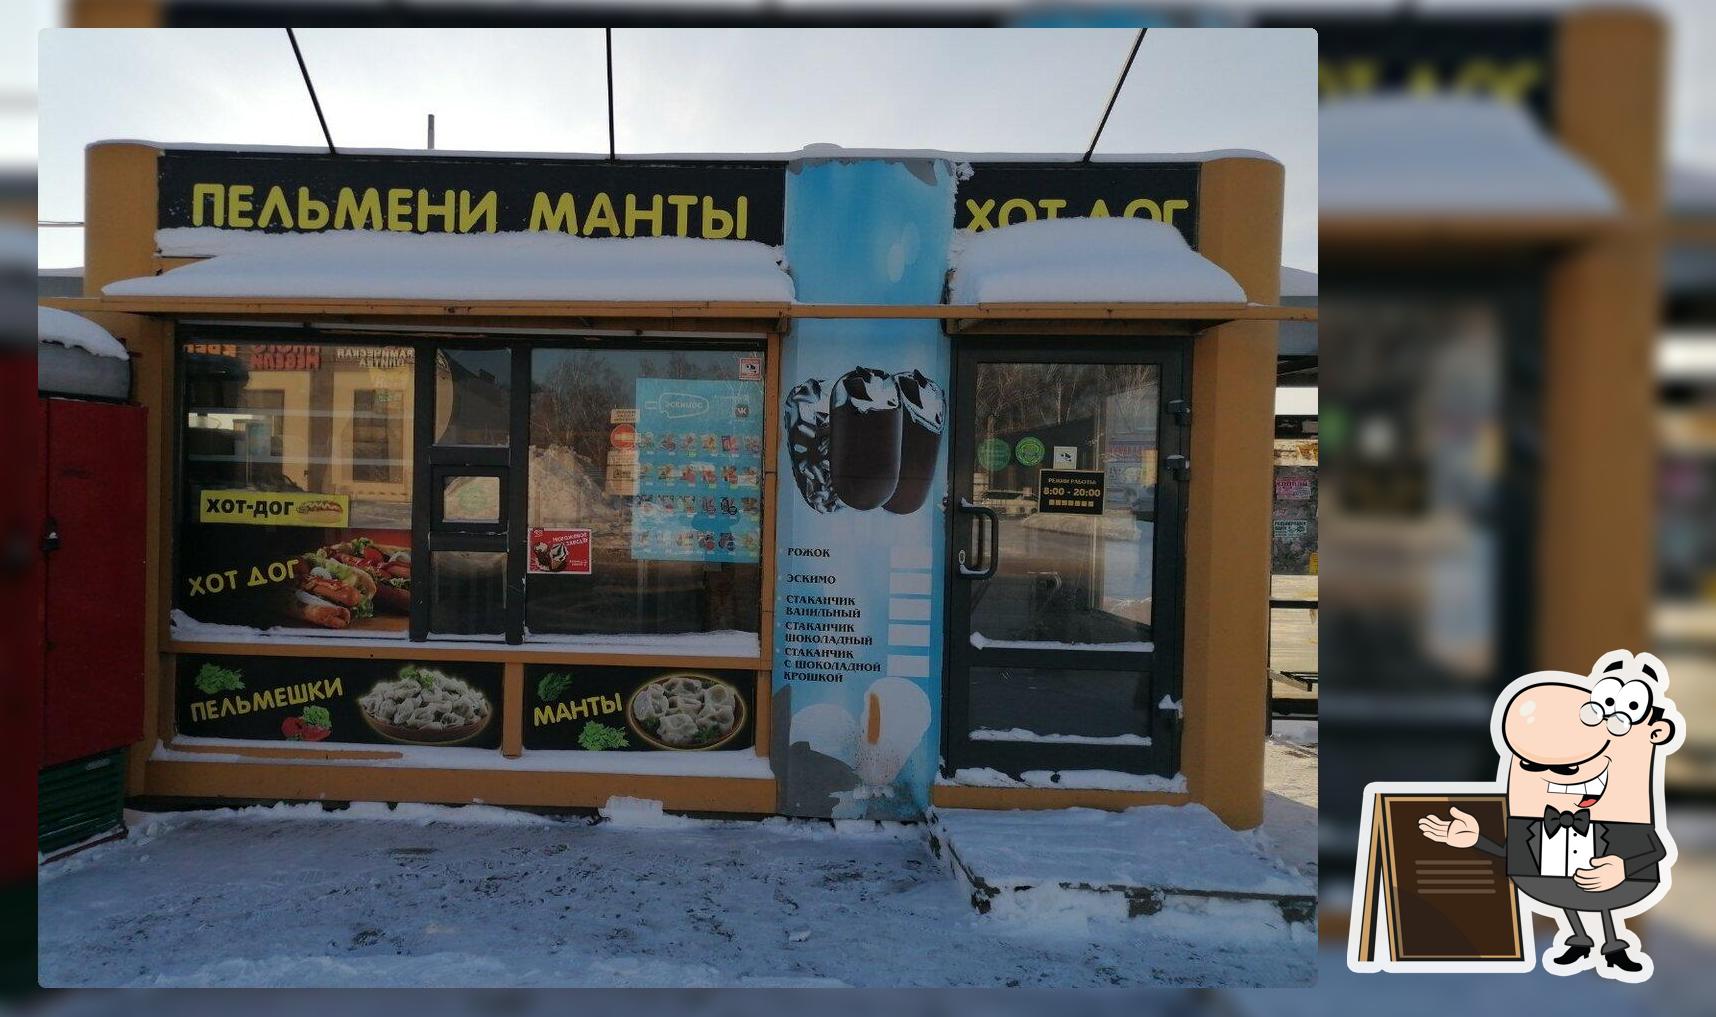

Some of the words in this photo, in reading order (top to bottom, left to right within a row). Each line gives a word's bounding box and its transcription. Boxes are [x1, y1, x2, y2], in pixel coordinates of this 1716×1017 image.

[191, 182, 498, 234] ПЕЛЬМЕНИ
[529, 190, 749, 240] МАНТЫ
[965, 197, 1068, 234] ХОТ
[1043, 486, 1065, 496] 8:00
[1073, 488, 1101, 497] 20:00
[205, 497, 295, 518] ХОТ-ДОГ
[786, 547, 831, 558] РОЖОК
[188, 570, 238, 597] ХОТ
[246, 557, 300, 588] ДОГ
[786, 574, 837, 585] ЭСКИМО
[786, 594, 856, 606] СТАКАНЧИК
[785, 606, 861, 619] ВАНИЛЬНЫЙ
[785, 621, 855, 633] СТАКАНЧИК
[784, 633, 873, 646] ШОКОЛАДНЫЙ
[784, 648, 855, 659] СТАКАНЧИК
[783, 660, 792, 669] С
[795, 660, 881, 673] ШОКОЛАДНОЙ
[783, 671, 843, 683] КРОШКОЙ
[189, 676, 344, 723] ПЕЛЬМЕШКИ
[532, 691, 624, 728] МАНТЫ
